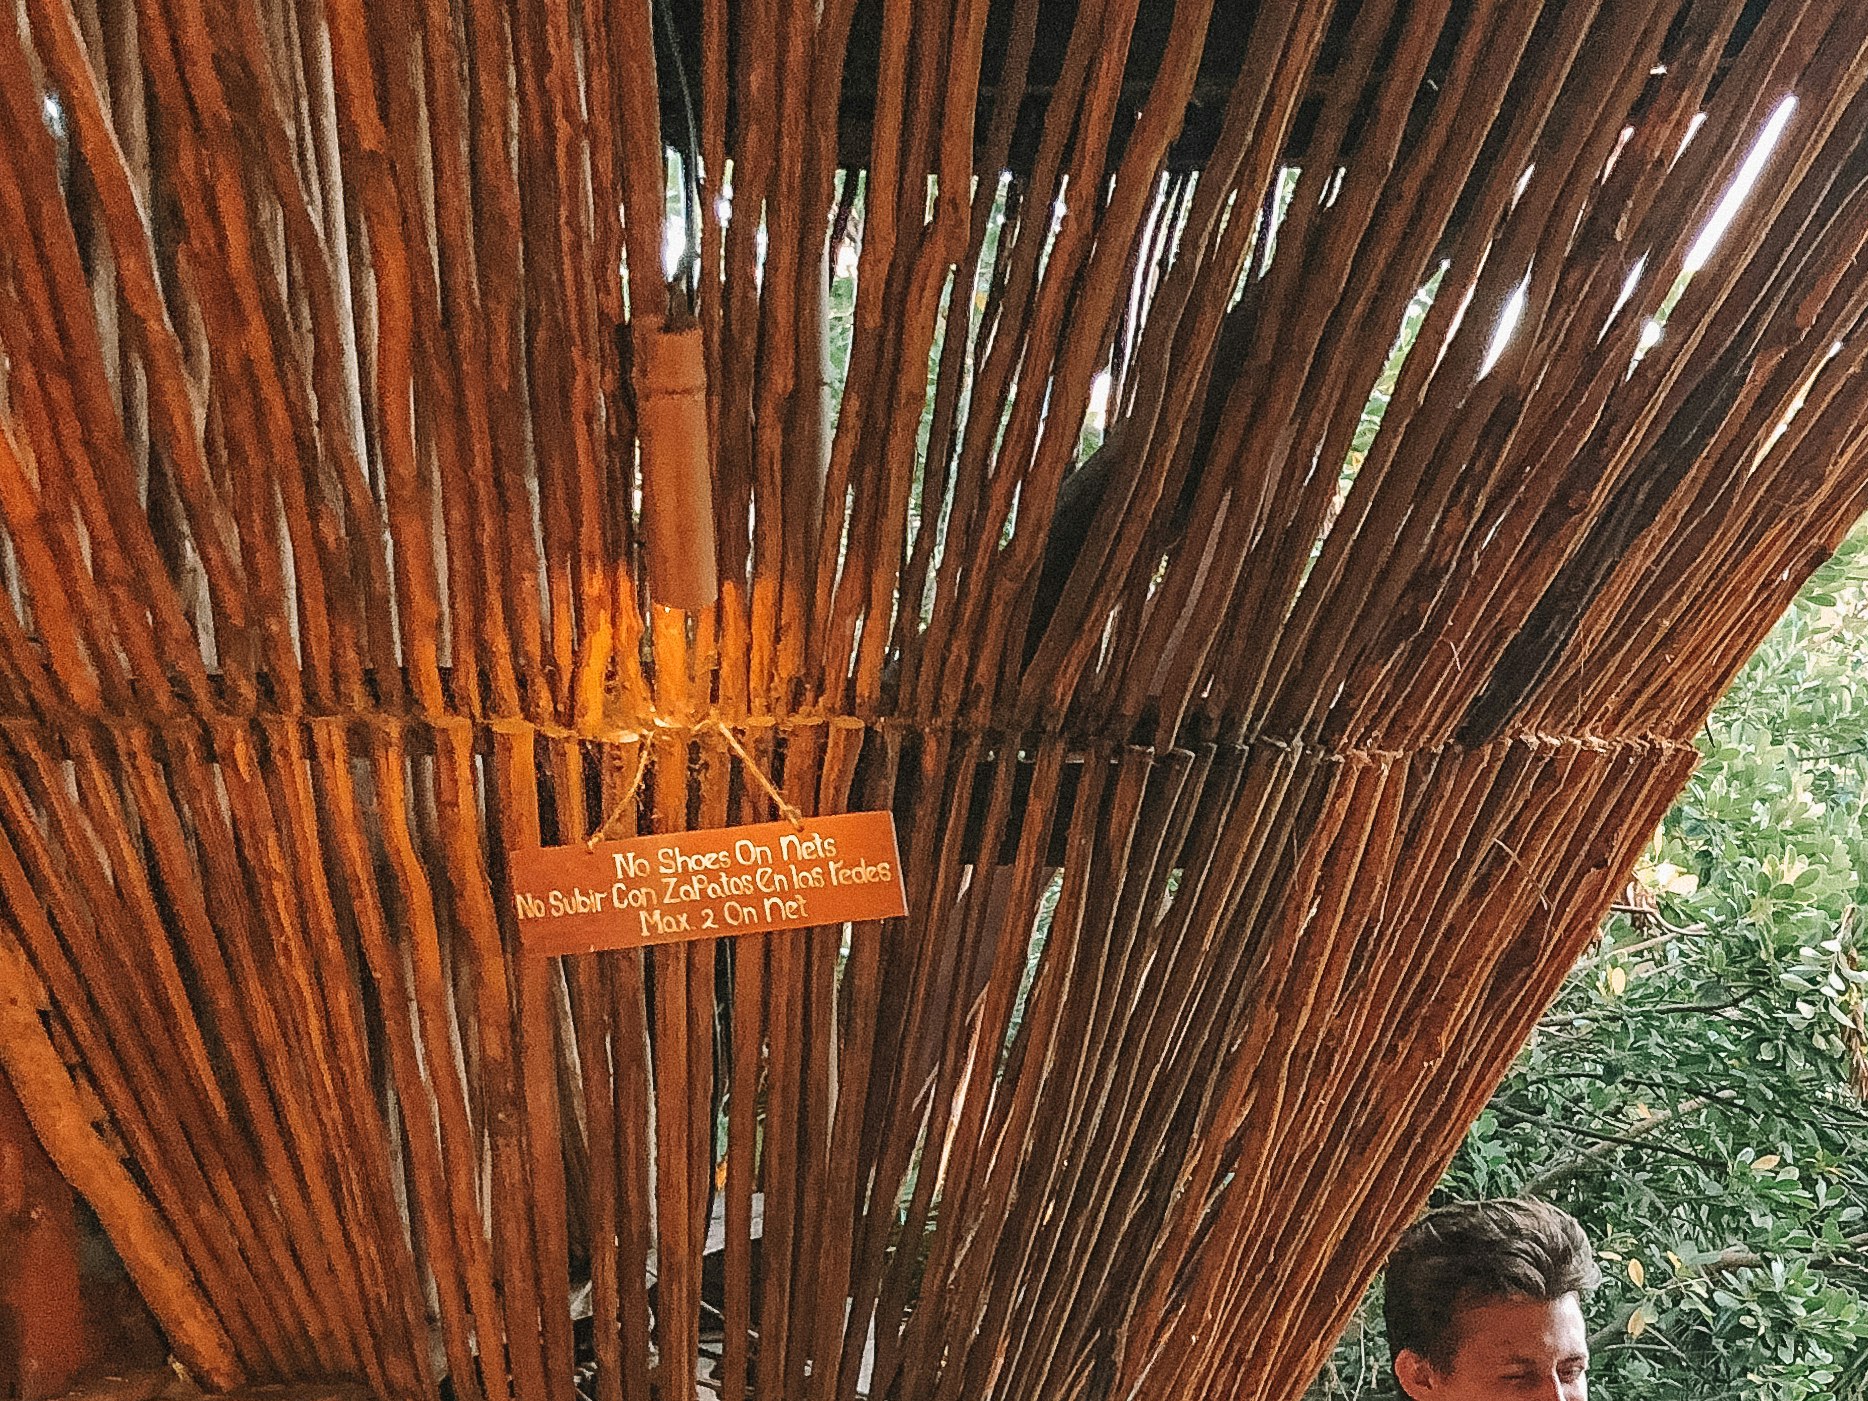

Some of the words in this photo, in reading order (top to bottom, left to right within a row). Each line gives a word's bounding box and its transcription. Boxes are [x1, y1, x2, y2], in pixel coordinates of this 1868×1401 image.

[613, 853, 650, 880] No
[658, 847, 730, 874] Shoes
[735, 839, 772, 866] On
[516, 894, 545, 919] No
[549, 888, 607, 916] Subir
[613, 885, 657, 909] Con
[792, 864, 824, 890] las
[701, 912, 718, 929] 2
[724, 903, 758, 926] On
